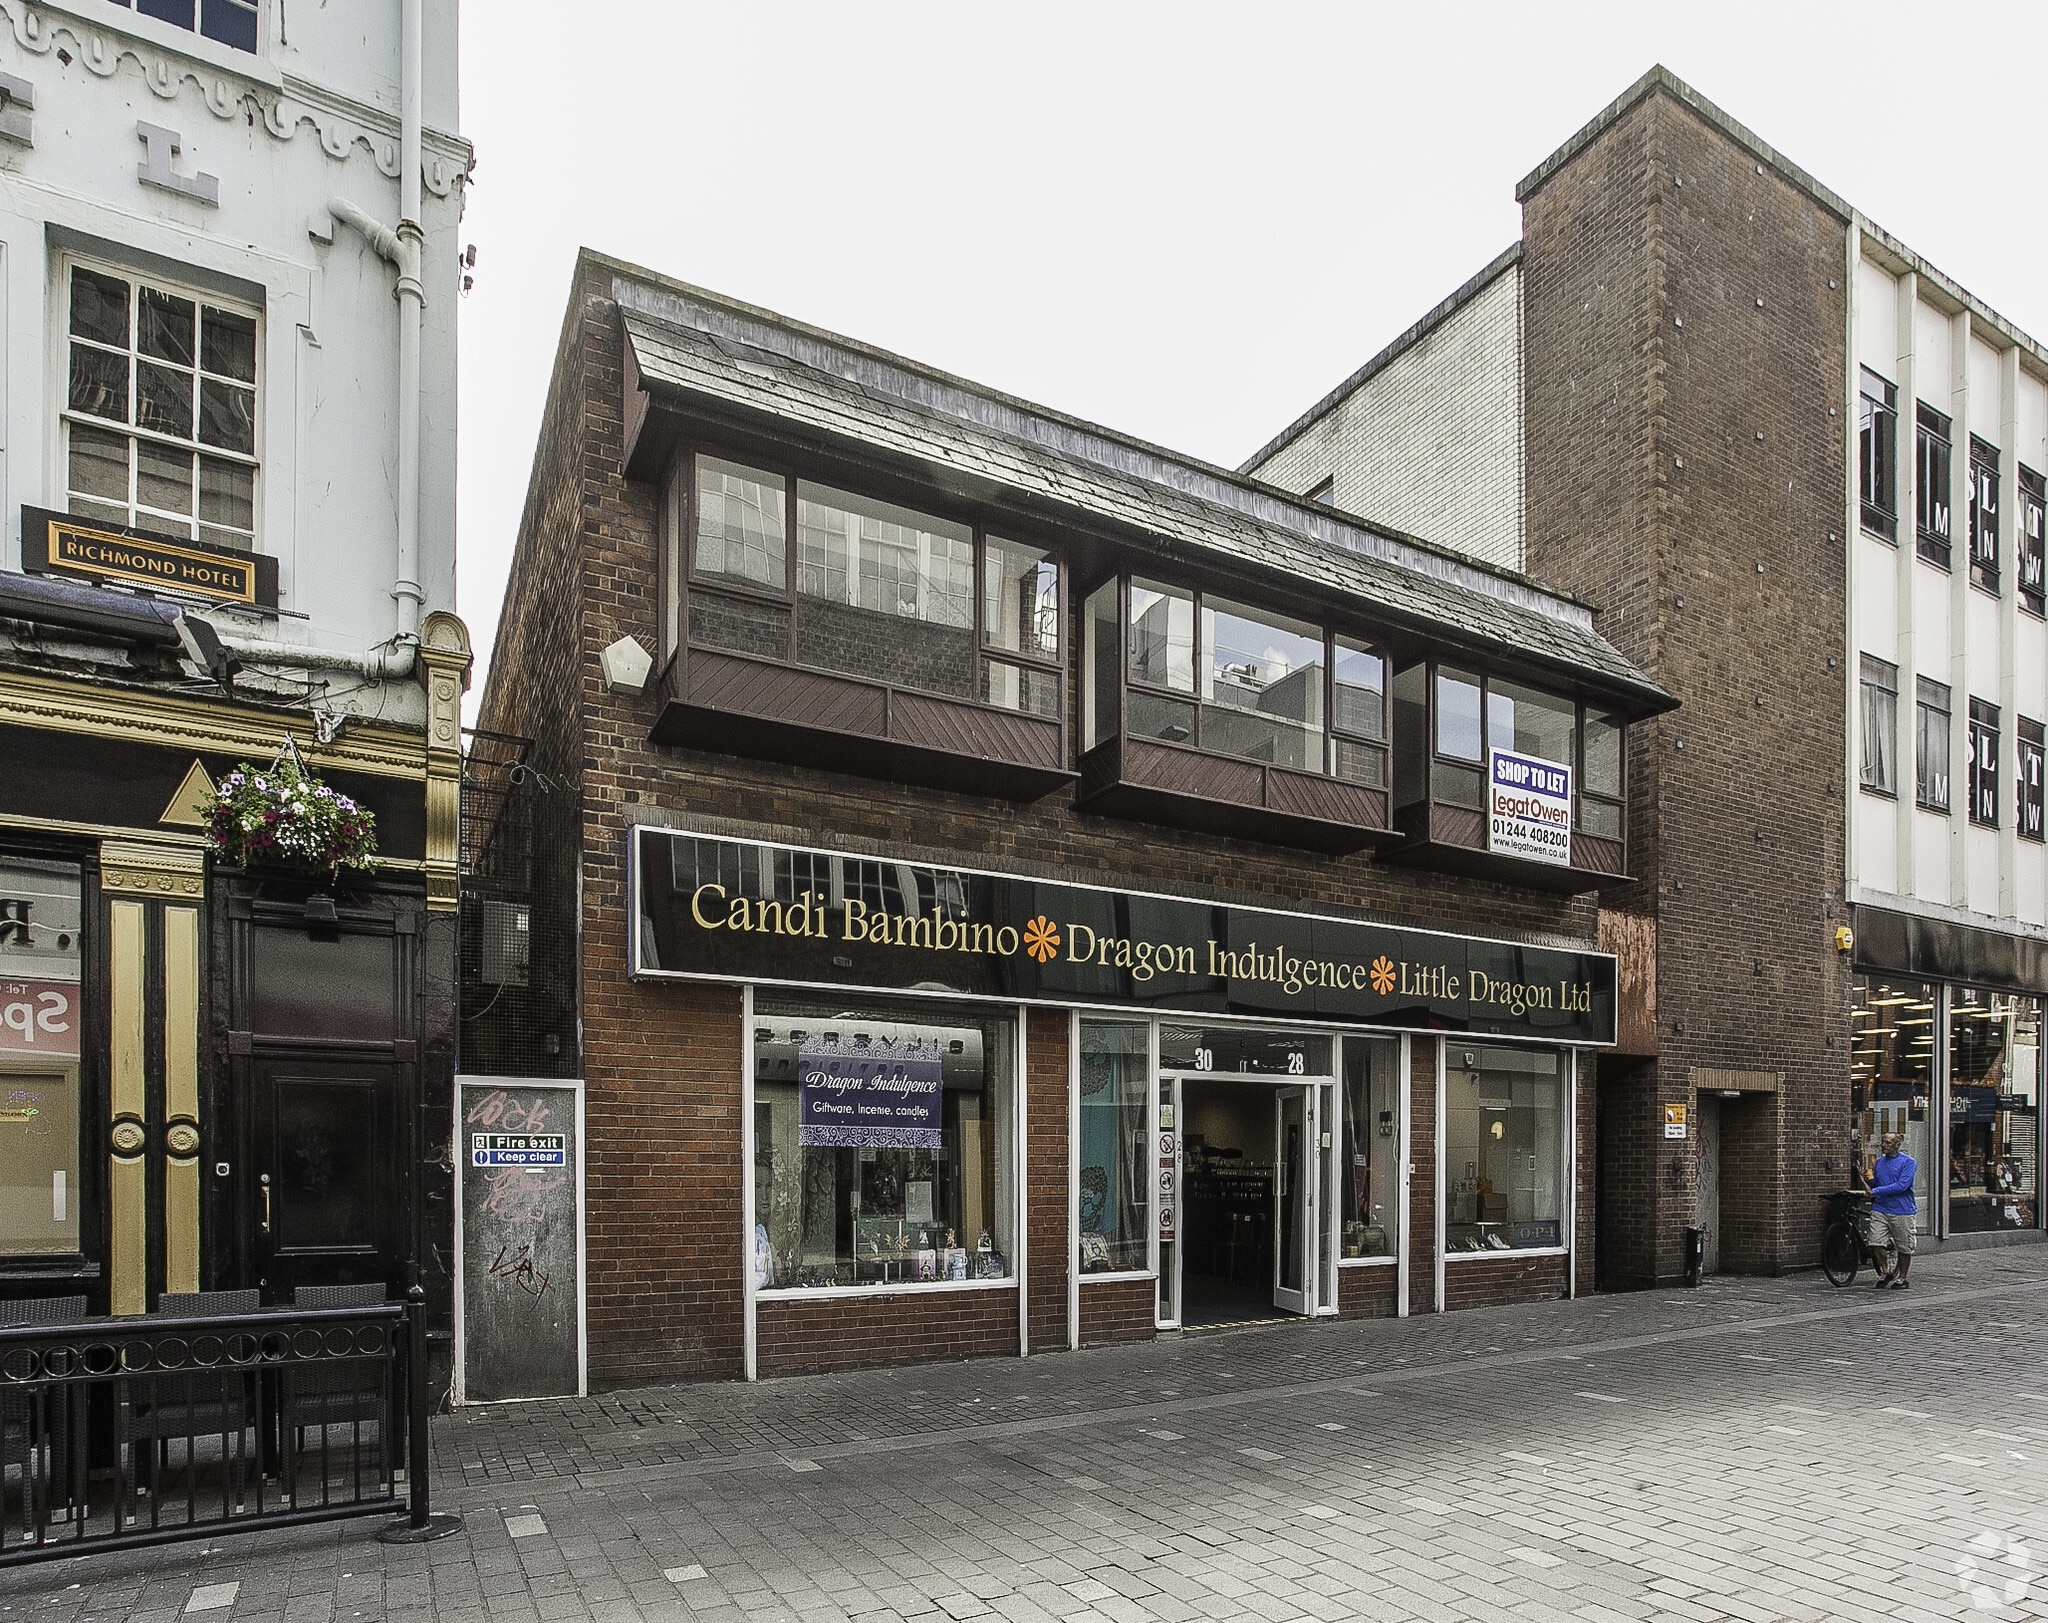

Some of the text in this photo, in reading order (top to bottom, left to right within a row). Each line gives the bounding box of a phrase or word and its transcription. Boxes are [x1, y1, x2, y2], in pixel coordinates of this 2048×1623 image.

[66, 541, 240, 589] RICHMOND HOTEL
[1497, 759, 1565, 793] SHOP TO LET
[1493, 819, 1526, 839] 01244
[1530, 827, 1568, 847] 408200
[1493, 837, 1567, 859] www.legatowen.co.uk
[692, 883, 1592, 1015] Candi Bambino Dragon Indulgence Little Dragon Ltd
[1195, 1048, 1304, 1074] 30 28
[806, 1071, 937, 1099] Dragon Indulgence
[896, 1105, 929, 1117] candles
[497, 1137, 558, 1148] Fire exit
[497, 1151, 558, 1163] Keep clear
